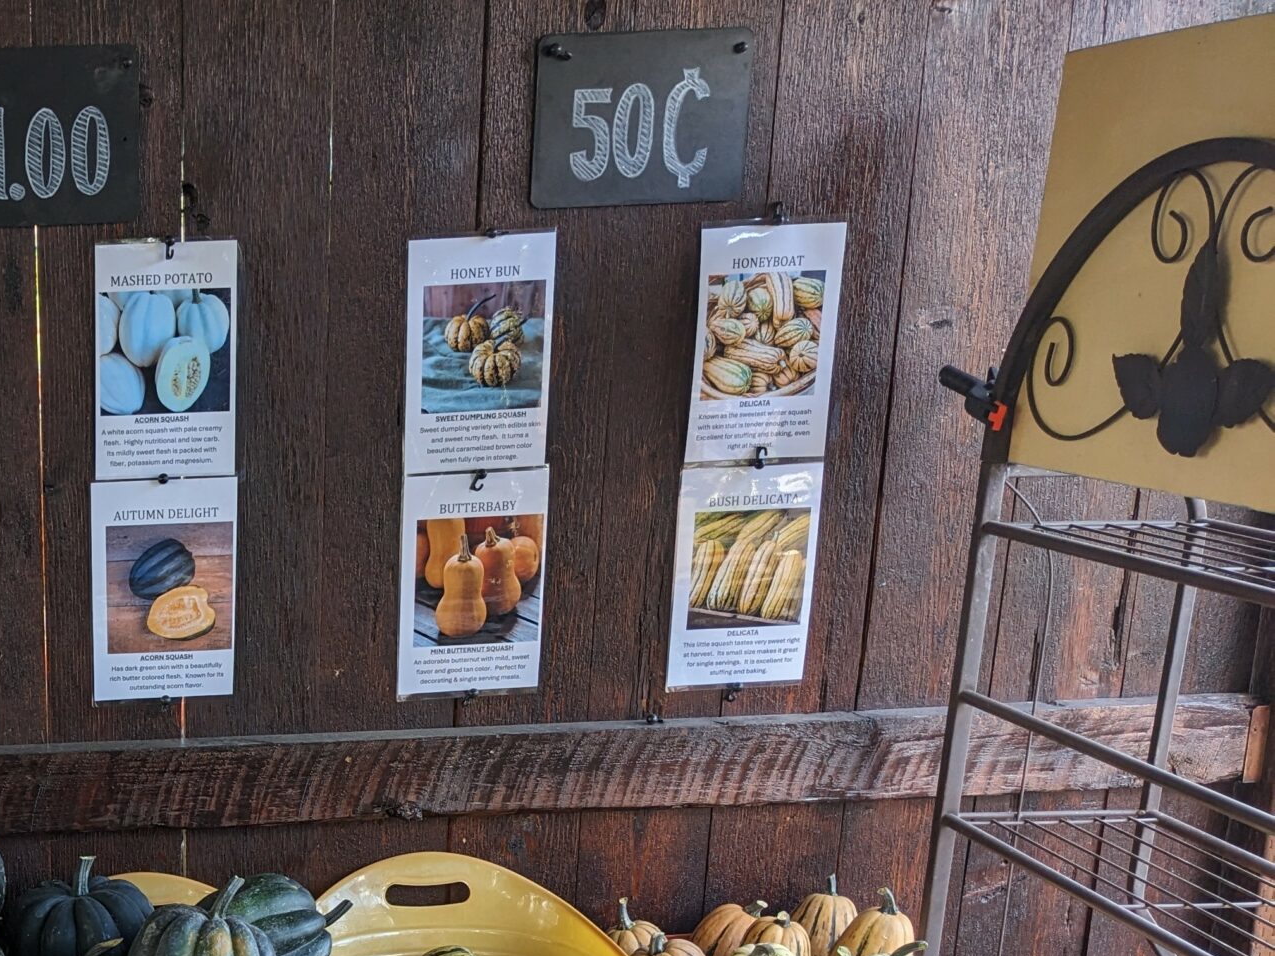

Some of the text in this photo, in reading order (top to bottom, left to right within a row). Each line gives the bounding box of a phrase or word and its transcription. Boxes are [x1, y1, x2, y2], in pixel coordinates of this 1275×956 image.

[732, 255, 805, 269] HONEYBOAT
[450, 265, 520, 280] HONEY BUN
[110, 272, 213, 287] MASHED POTATO
[435, 414, 458, 422] SWEET
[460, 413, 497, 421] DUMPLING
[766, 420, 788, 428] enough
[184, 426, 197, 434] pale
[199, 425, 222, 433] creamy
[458, 456, 471, 464] fully
[473, 455, 485, 463] ripe
[709, 493, 800, 507] BUSH DELICATA
[439, 500, 517, 514] BUTTERBABY
[114, 507, 219, 521] AUTUMN DELIGHT
[727, 629, 759, 637] DELICATA
[446, 646, 485, 654] BUTTERNUT
[710, 668, 731, 676] stuffing
[420, 676, 452, 684] decorating
[459, 675, 477, 683] single
[129, 683, 165, 691] outstanding
